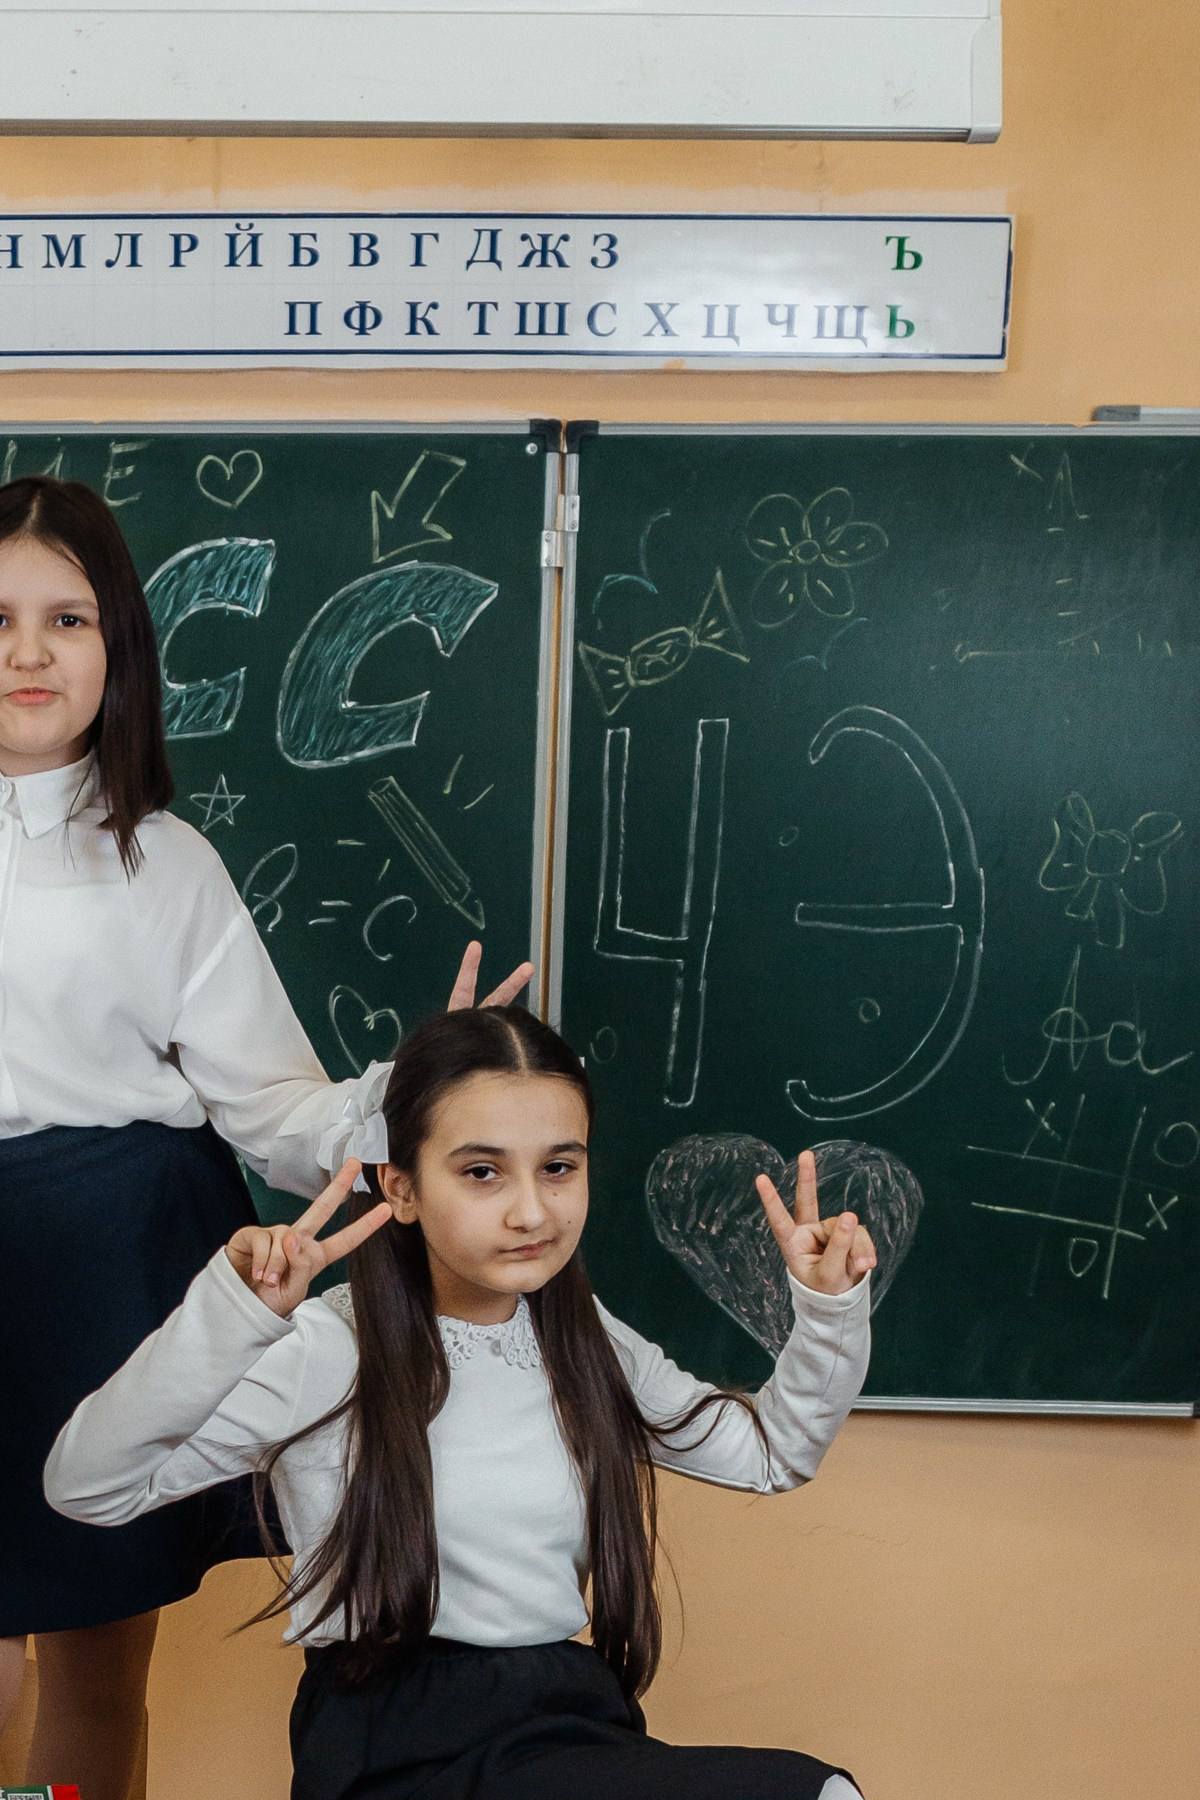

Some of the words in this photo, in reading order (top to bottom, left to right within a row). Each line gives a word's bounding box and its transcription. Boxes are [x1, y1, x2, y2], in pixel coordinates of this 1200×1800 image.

[41, 233, 87, 269] М
[104, 232, 143, 269] Л
[168, 232, 199, 268] Р
[223, 224, 264, 268] Й
[287, 232, 320, 268] Б
[347, 232, 383, 268] В
[409, 232, 440, 268] Г
[465, 228, 503, 272] Д
[517, 233, 571, 269] Ж
[590, 232, 620, 270] З
[884, 235, 924, 271] Ъ
[283, 300, 323, 336] П
[342, 300, 383, 336] Ф
[404, 301, 441, 336] К
[466, 301, 499, 336] Т
[513, 301, 571, 336] Ш
[586, 301, 617, 337] С
[642, 302, 680, 338] Х
[702, 304, 740, 346] Ц
[762, 303, 797, 339] Ч
[813, 305, 869, 347] Щ
[885, 304, 916, 339] Ь
